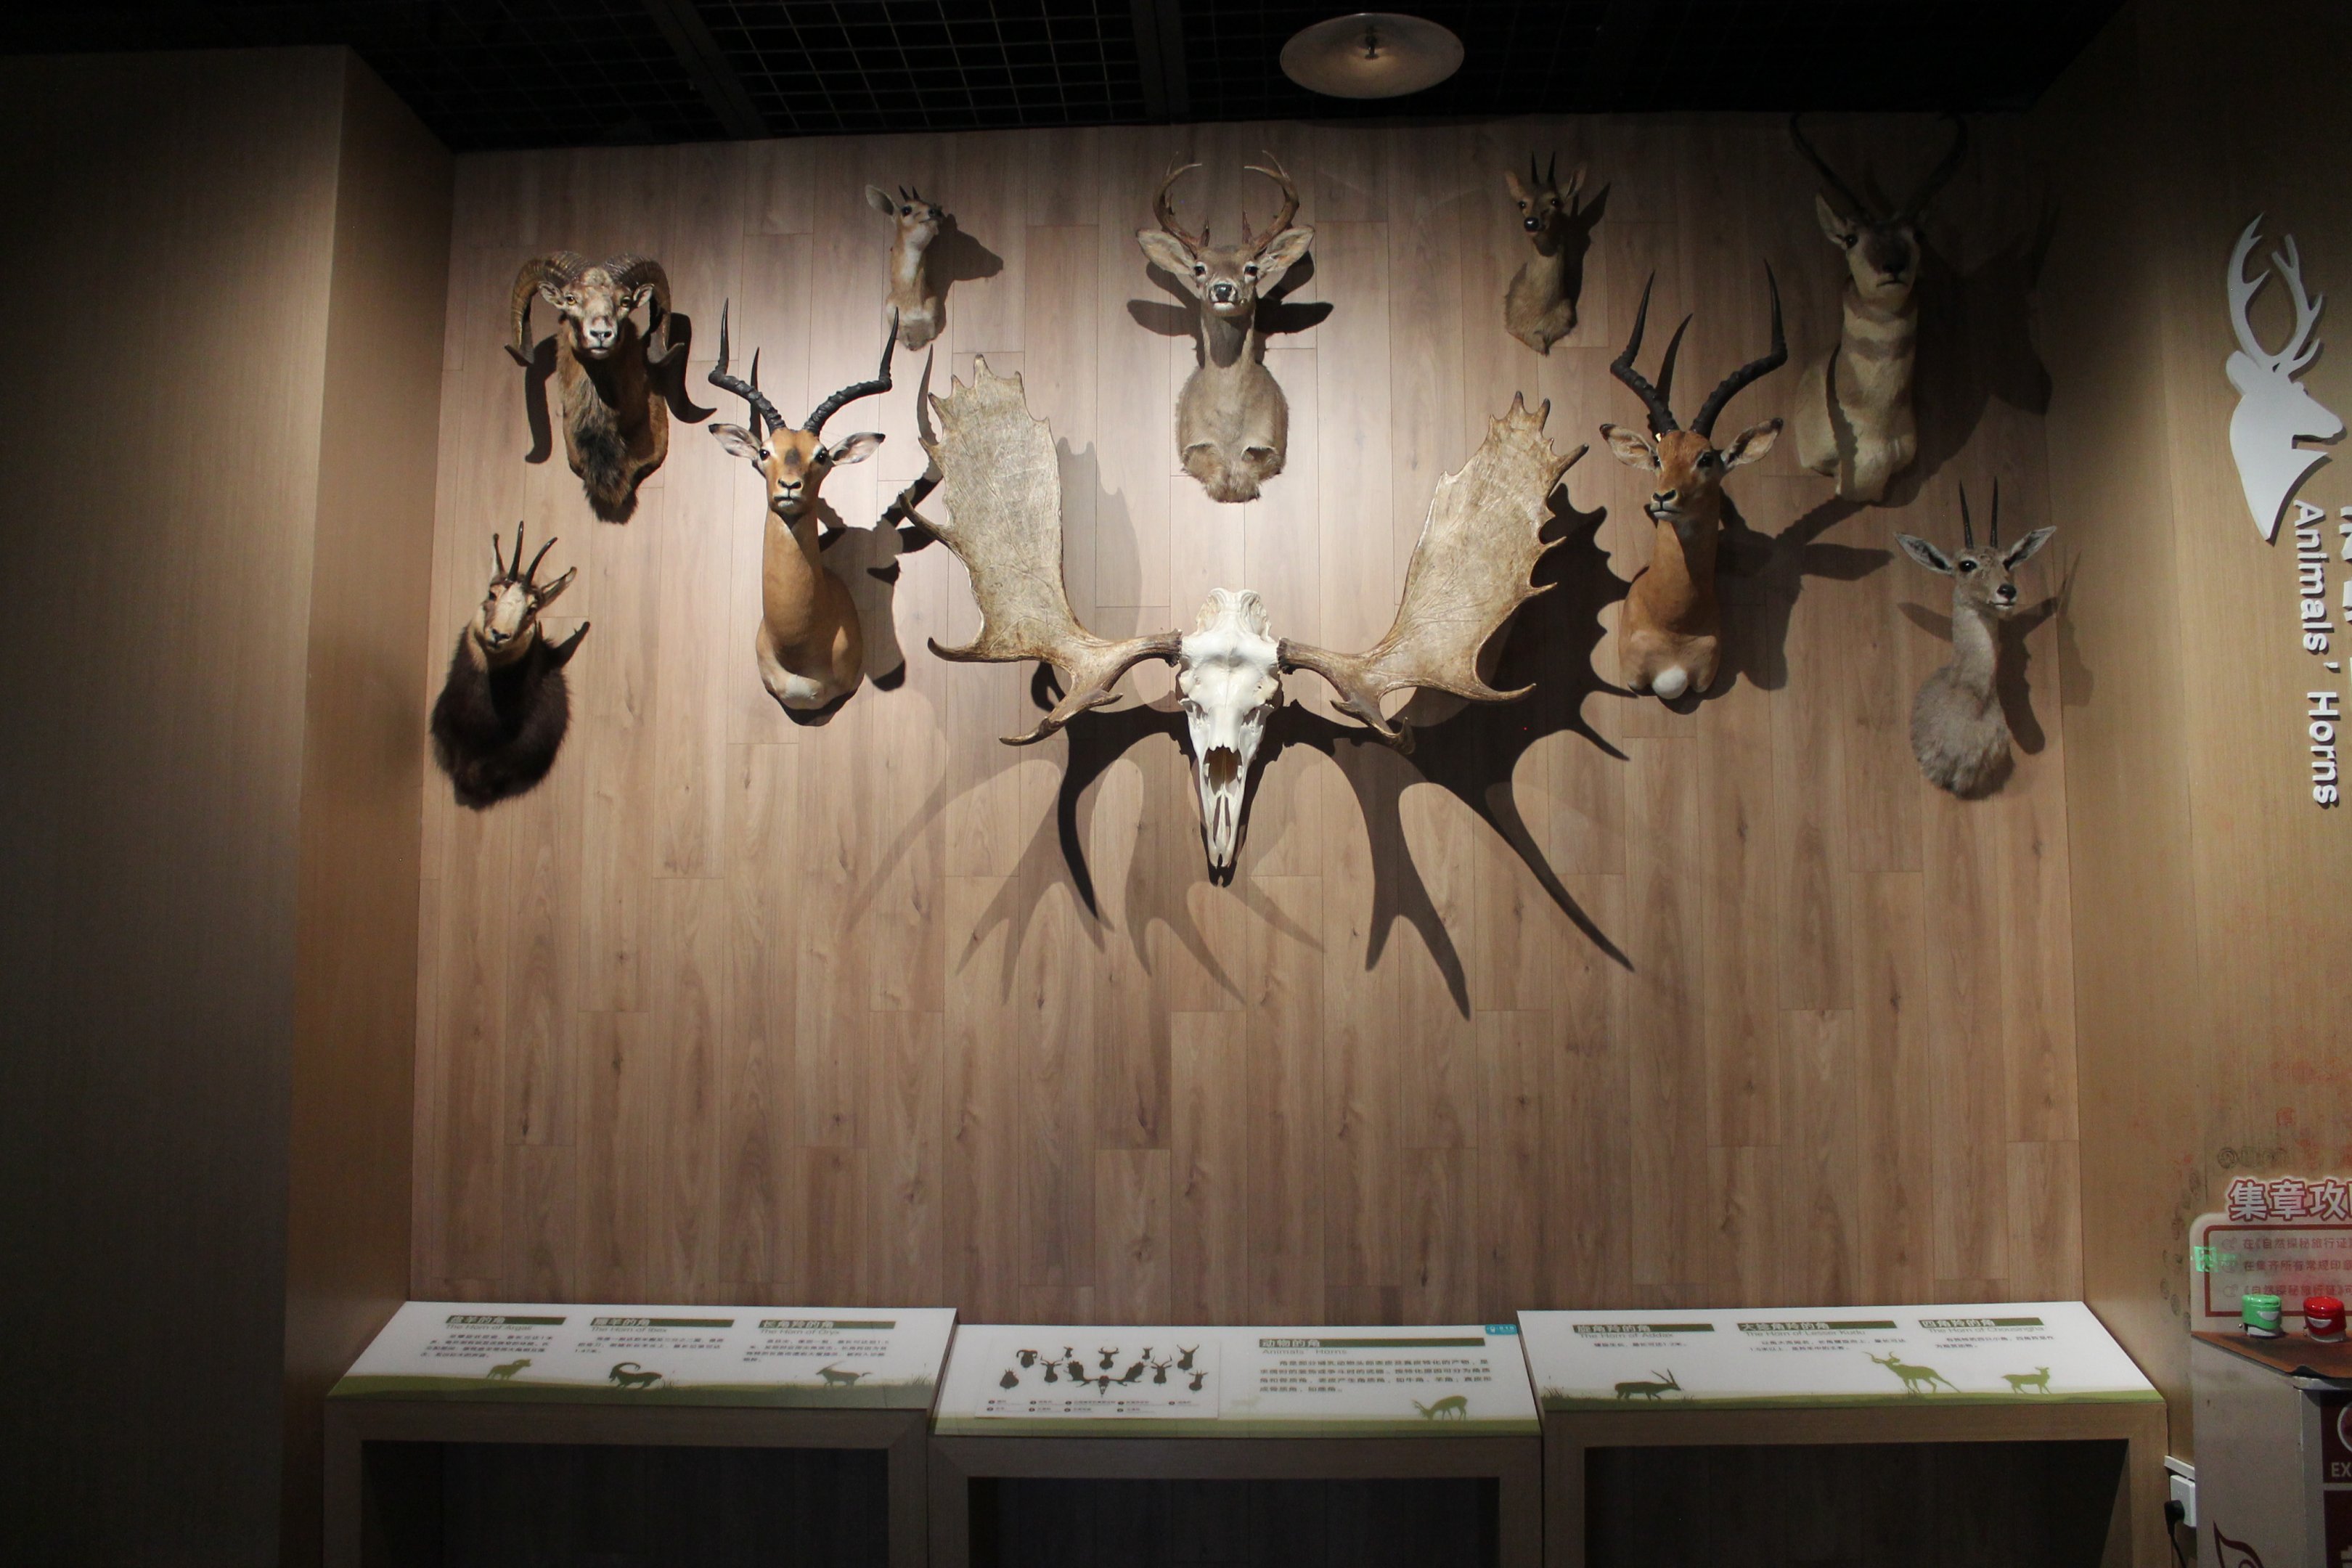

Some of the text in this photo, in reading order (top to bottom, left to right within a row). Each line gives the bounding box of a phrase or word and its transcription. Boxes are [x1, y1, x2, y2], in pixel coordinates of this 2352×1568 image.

[2307, 692, 2339, 804] Horns
[2228, 1179, 2352, 1222] 集章攻
